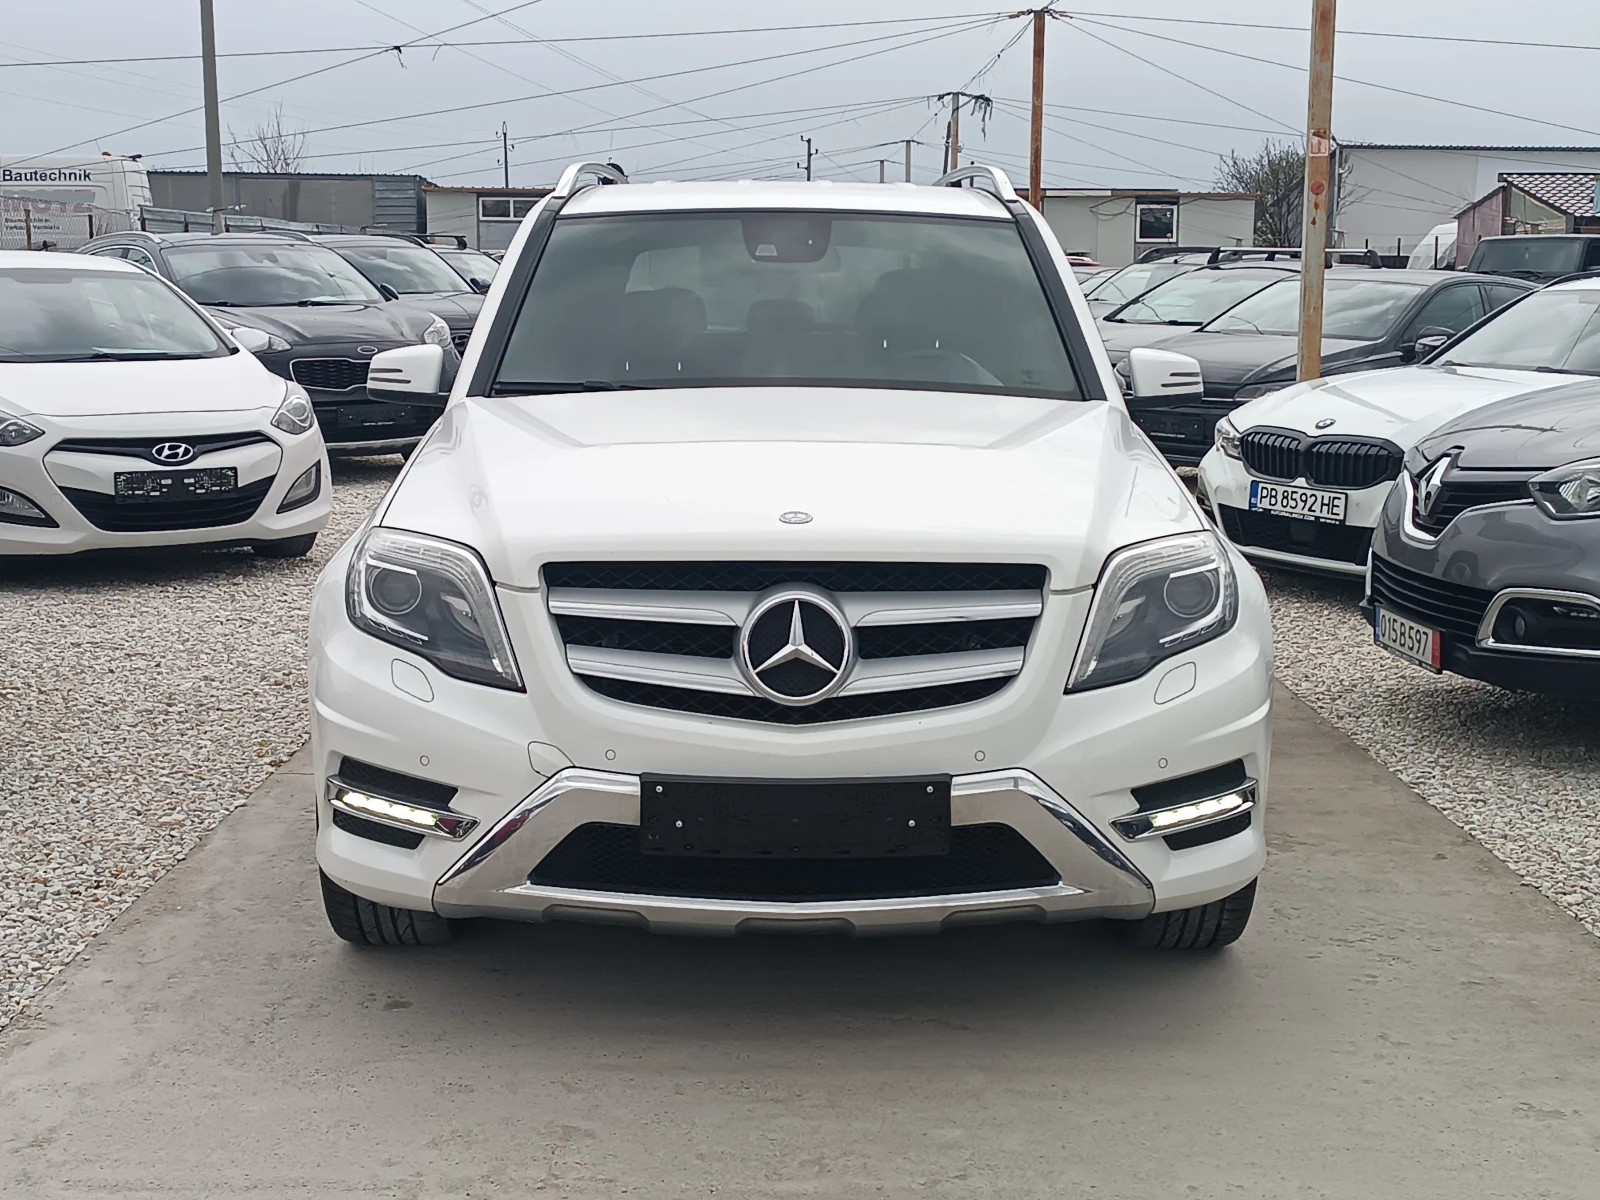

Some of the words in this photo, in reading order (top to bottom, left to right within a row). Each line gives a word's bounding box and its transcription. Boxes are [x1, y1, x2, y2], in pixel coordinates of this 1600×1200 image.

[2, 169, 92, 182] Bautechnik
[1259, 486, 1278, 506] PB
[1280, 490, 1318, 513] 8592
[1320, 494, 1342, 516] HE
